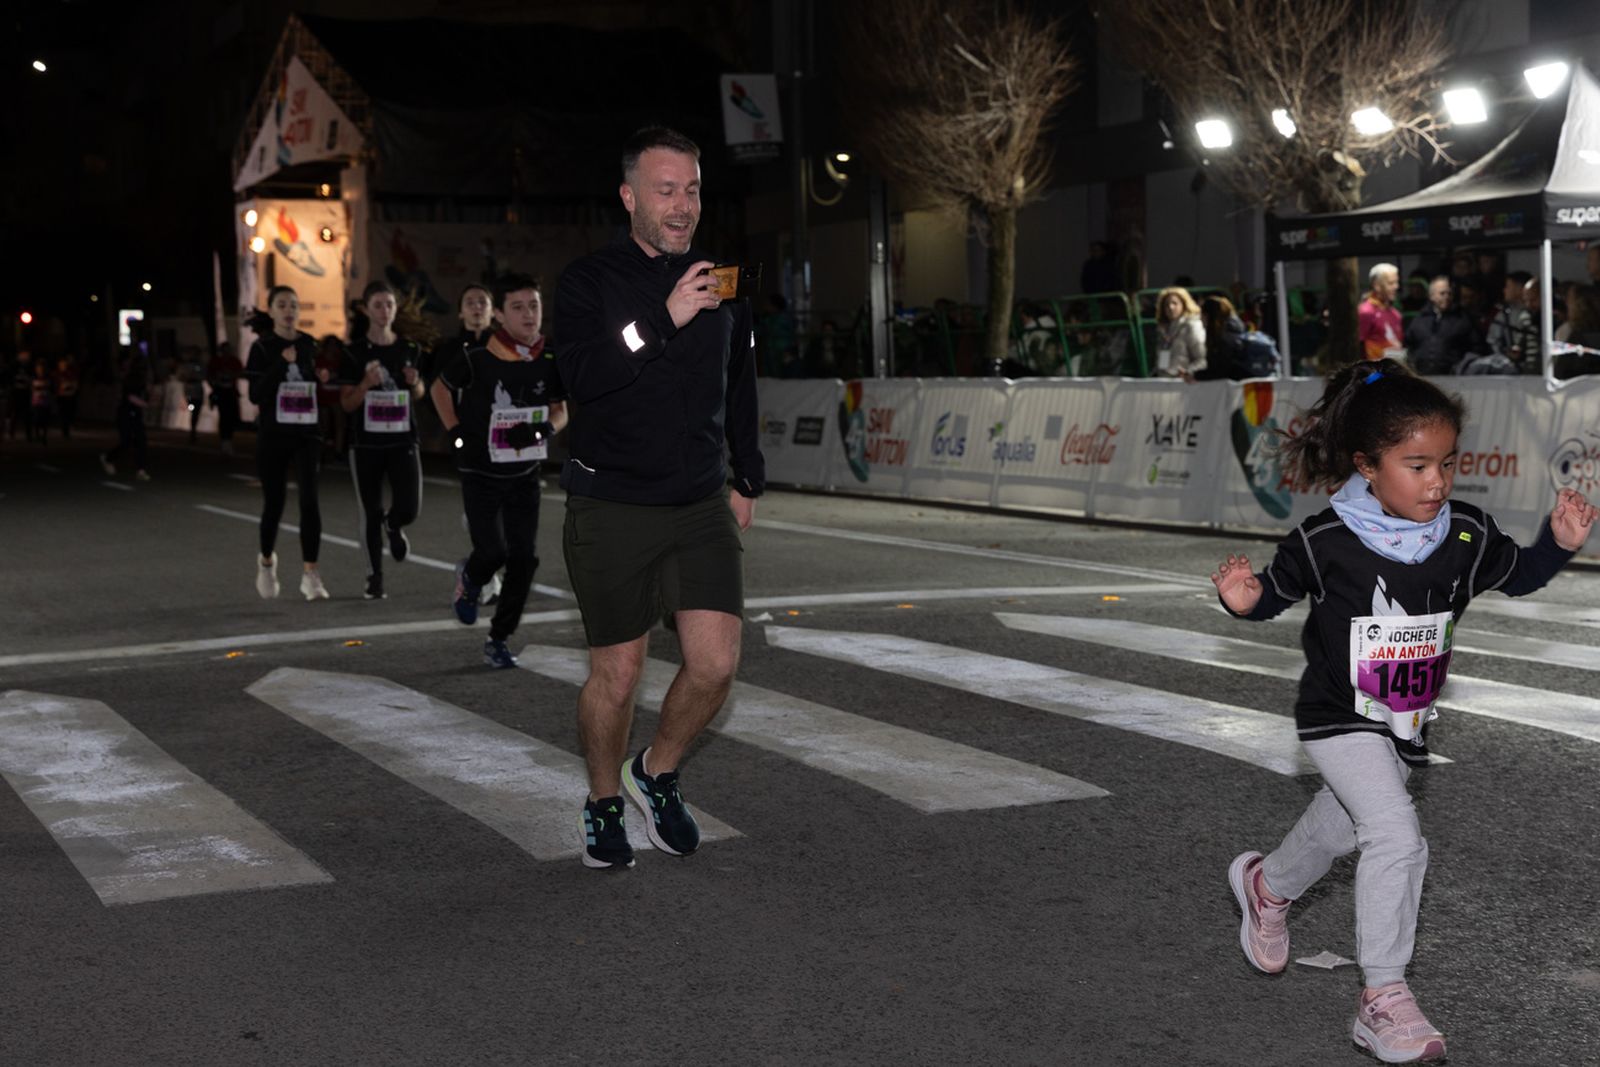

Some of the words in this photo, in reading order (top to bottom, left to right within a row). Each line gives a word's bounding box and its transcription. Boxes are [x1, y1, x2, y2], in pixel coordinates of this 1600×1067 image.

[867, 407, 896, 434] SAN
[864, 432, 911, 465] ANTÓN
[992, 435, 1037, 467] aqualia
[1458, 445, 1519, 478] erón
[1369, 646, 1396, 659] SAN
[1399, 642, 1437, 659] ANTÓN
[1387, 631, 1424, 643] NOCHE
[1425, 628, 1438, 641] DE
[1374, 660, 1448, 699] 1451
